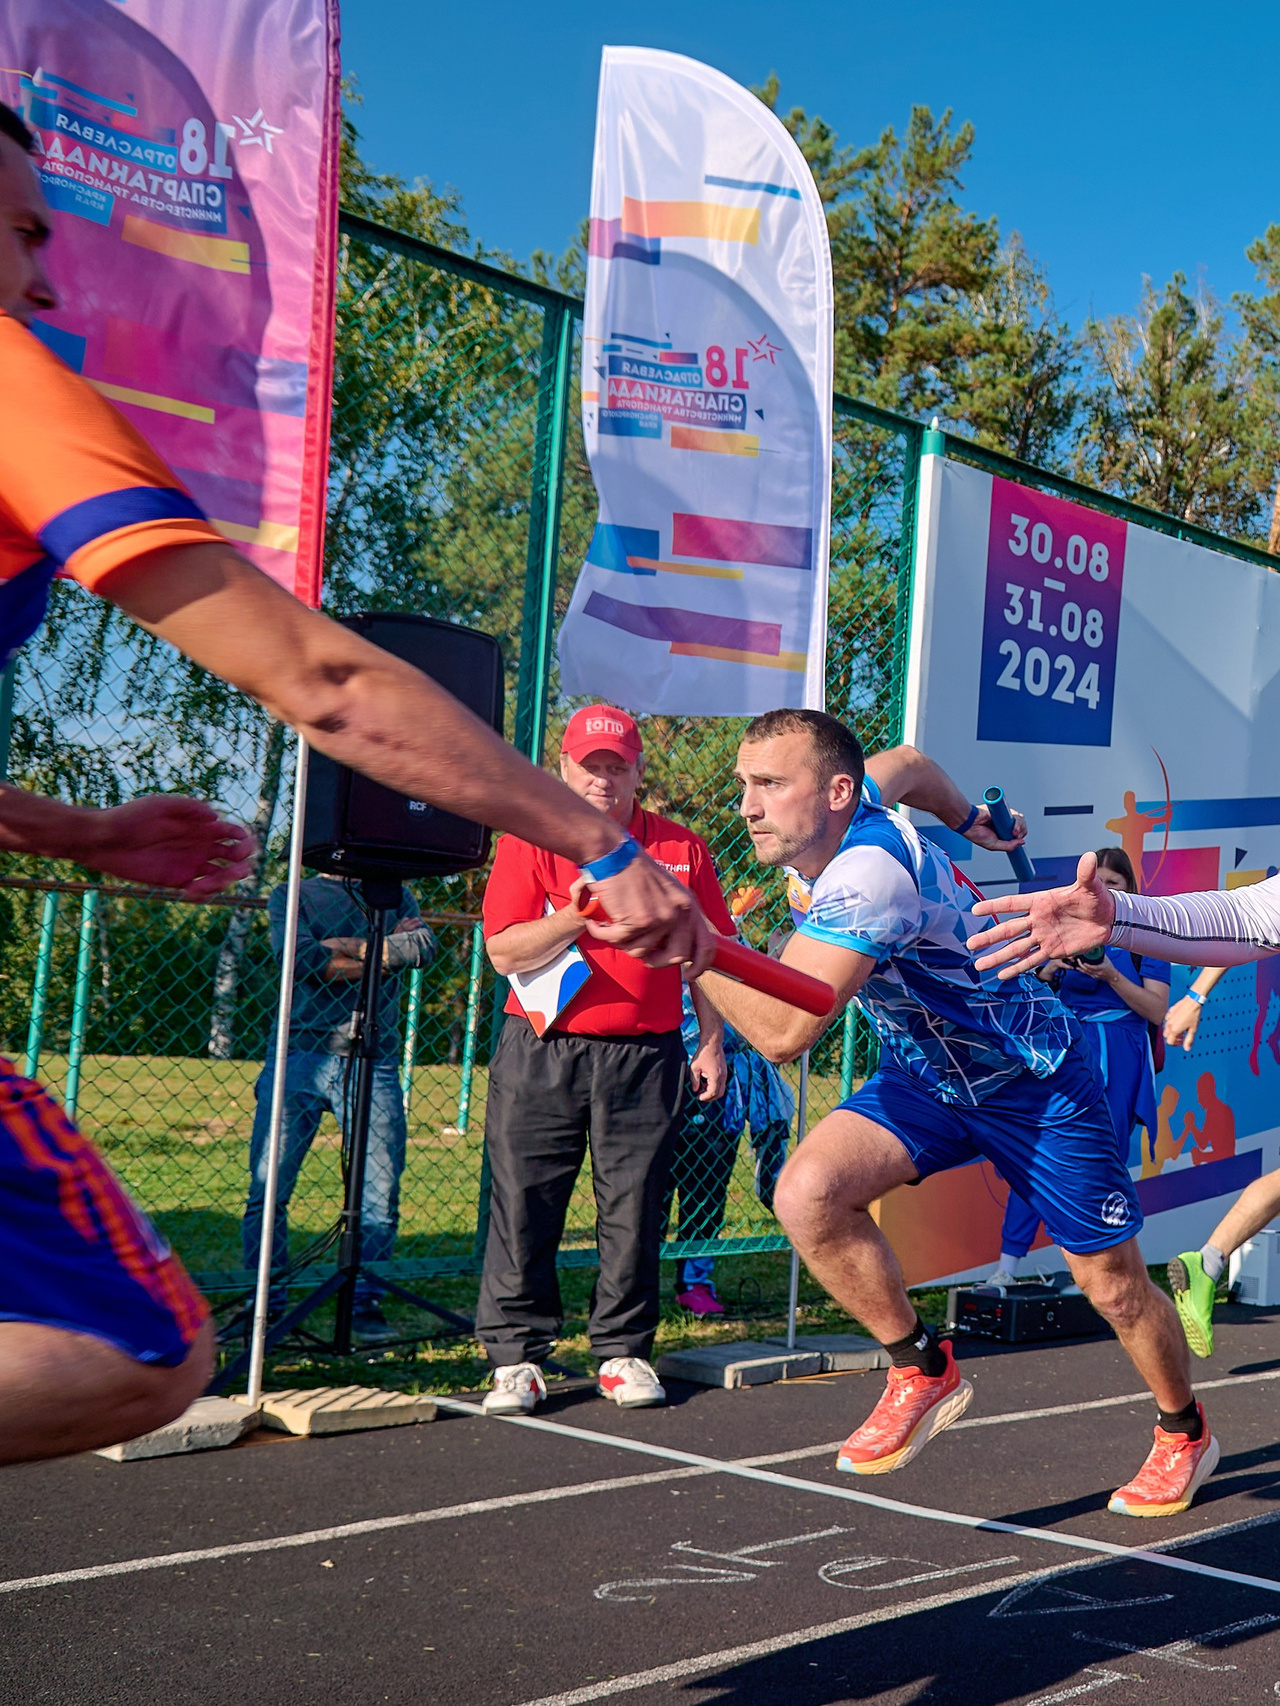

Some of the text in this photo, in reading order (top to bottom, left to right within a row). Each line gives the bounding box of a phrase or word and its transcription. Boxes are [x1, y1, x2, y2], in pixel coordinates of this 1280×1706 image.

[1008, 513, 1110, 582] 30.08
[1003, 582, 1104, 648] 31.08
[996, 639, 1101, 710] 2024
[409, 800, 427, 811] RCF
